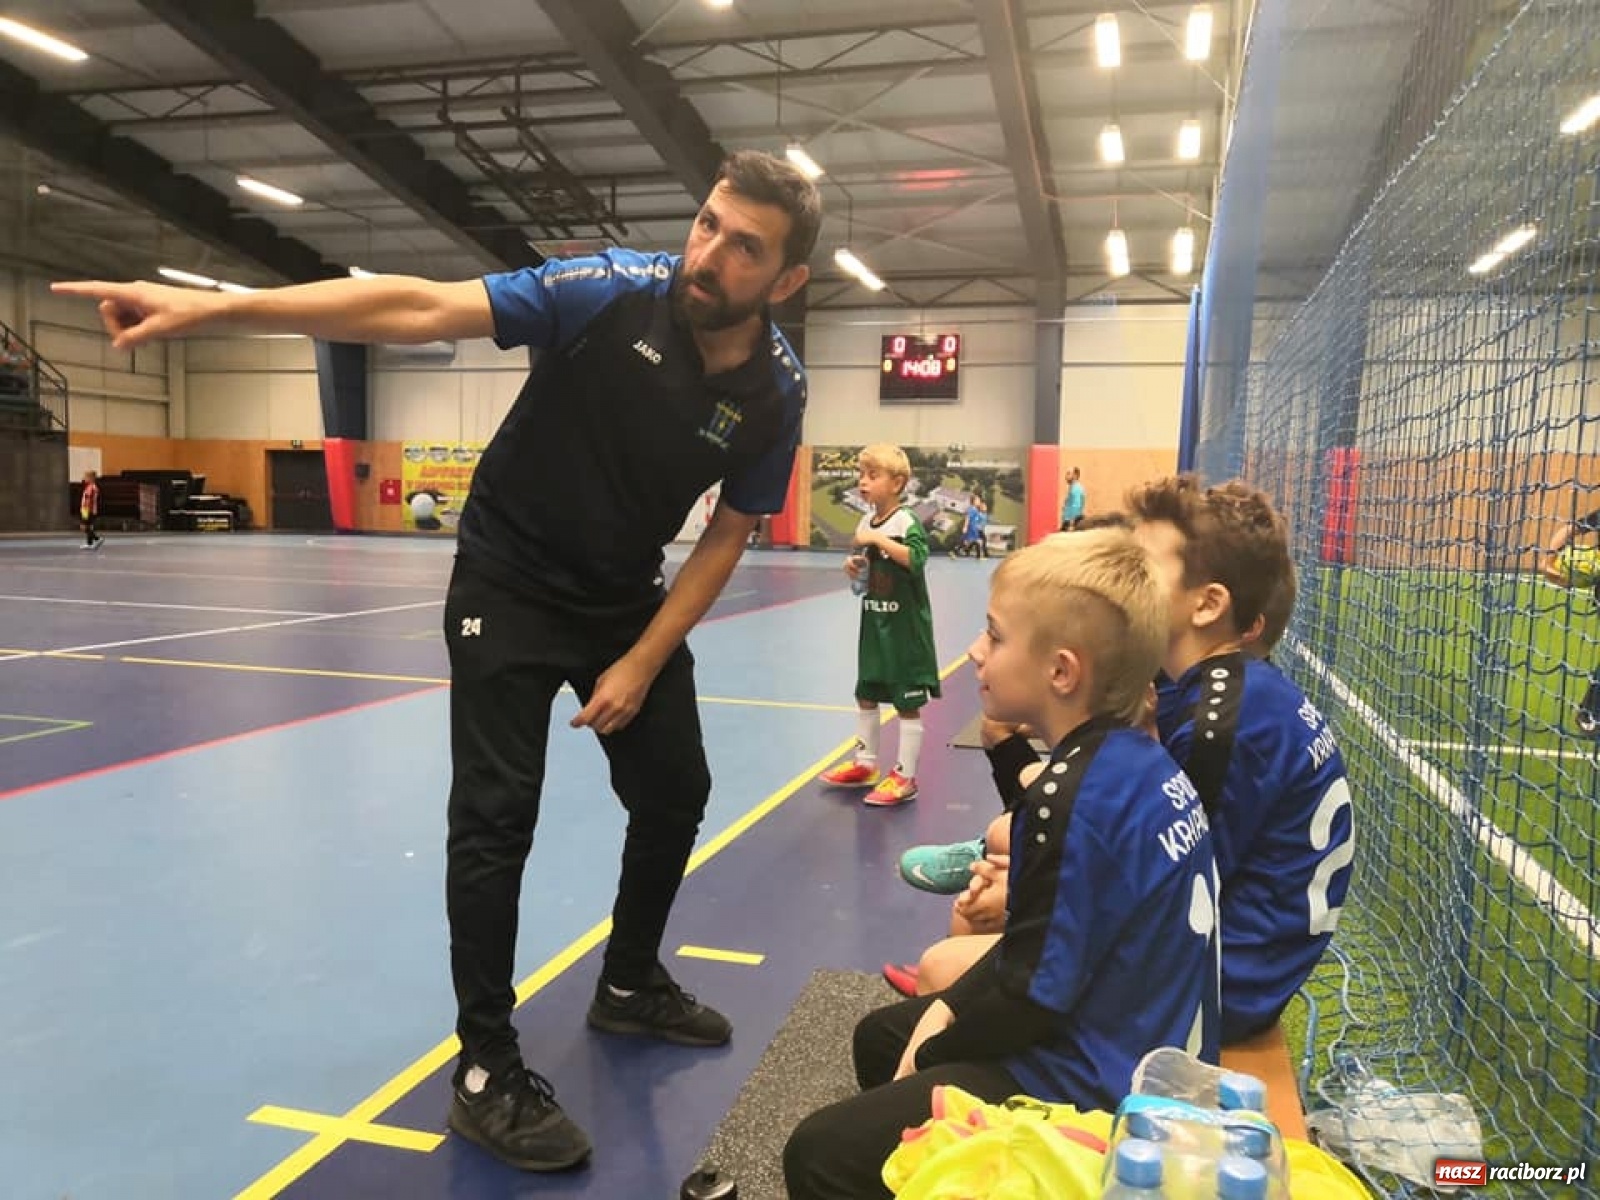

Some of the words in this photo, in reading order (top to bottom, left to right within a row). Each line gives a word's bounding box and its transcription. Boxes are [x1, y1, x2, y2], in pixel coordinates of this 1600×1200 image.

[632, 339, 663, 365] JAKO
[894, 336, 905, 353] 0
[944, 336, 956, 353] 0
[461, 617, 482, 636] 24
[1307, 776, 1356, 936] 2
